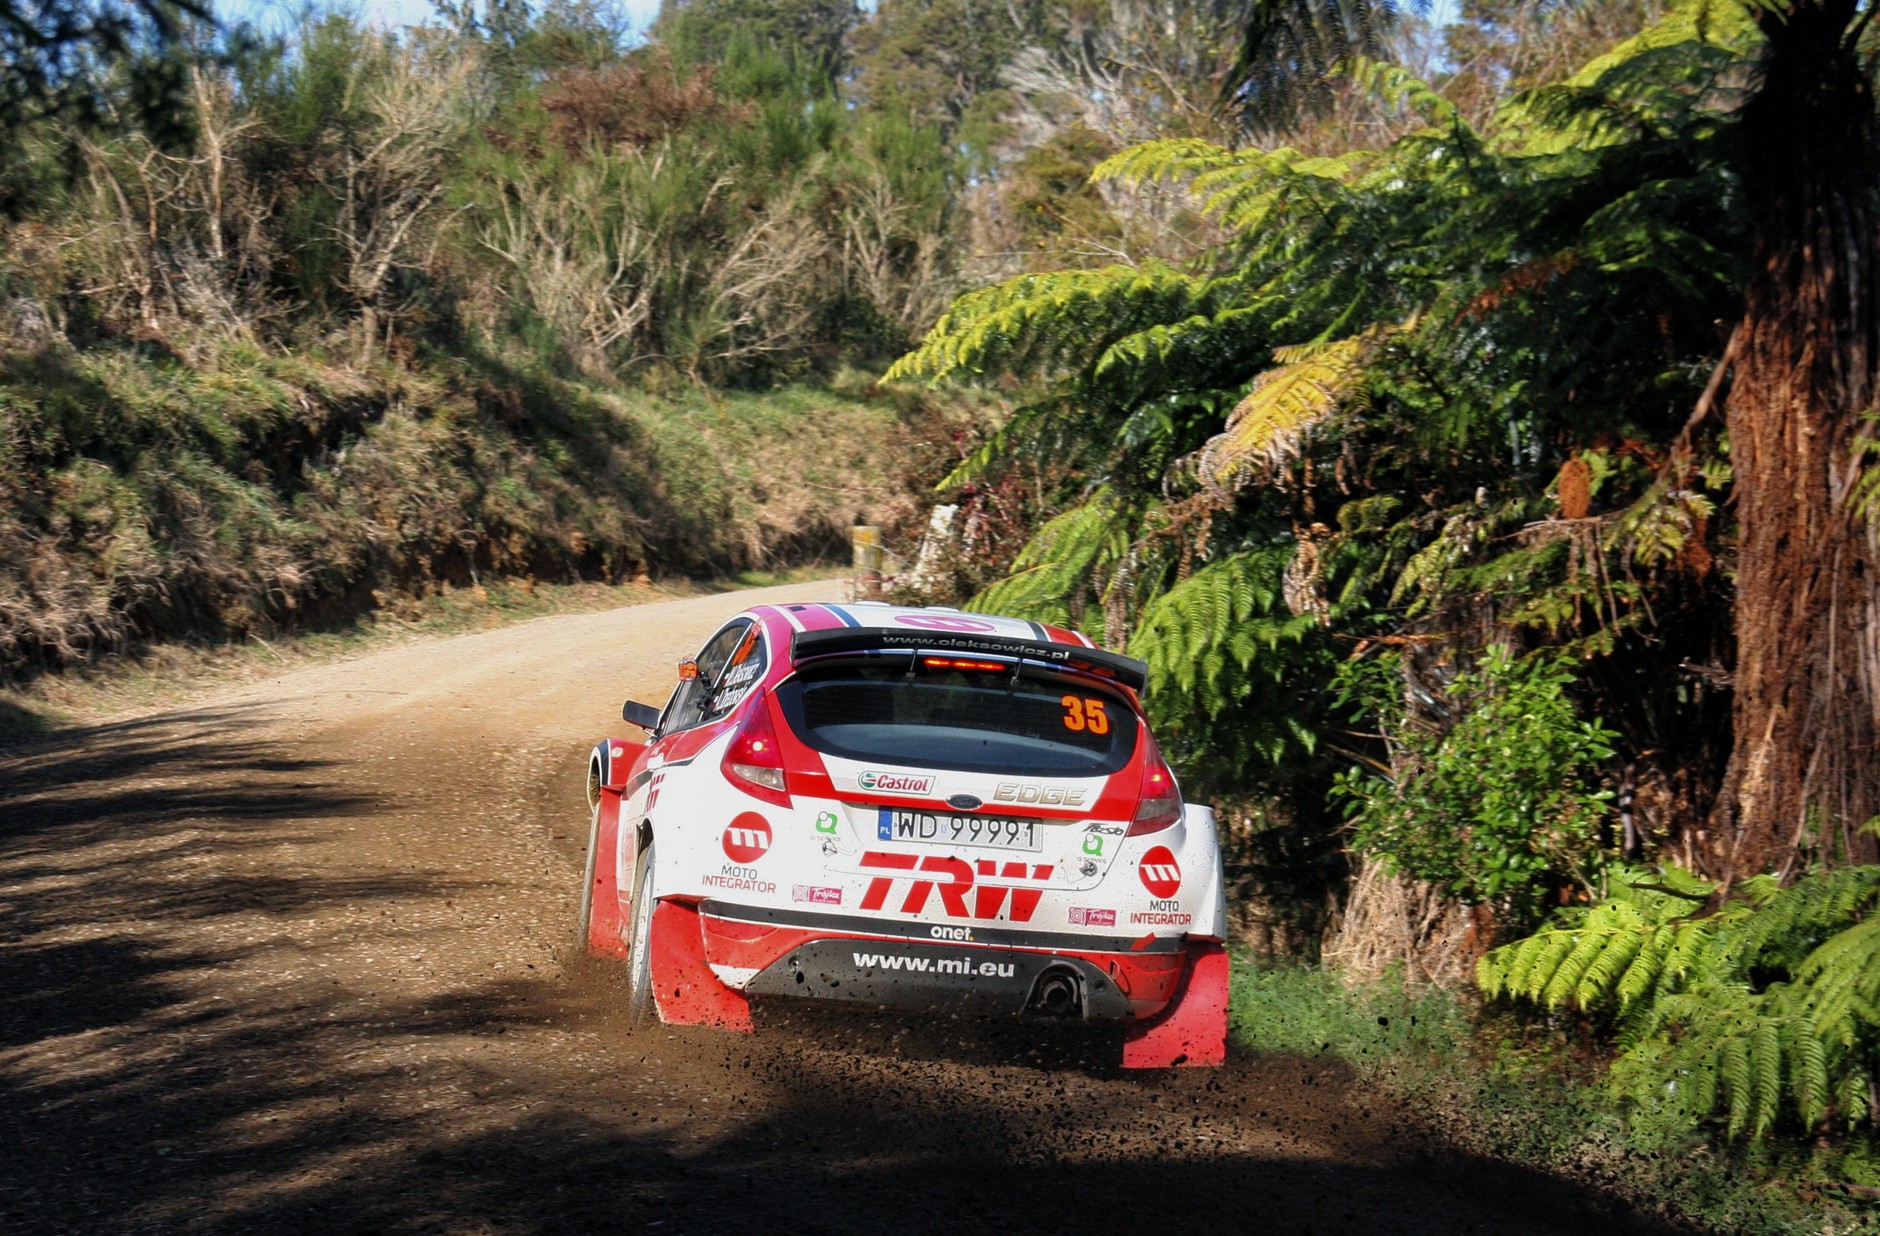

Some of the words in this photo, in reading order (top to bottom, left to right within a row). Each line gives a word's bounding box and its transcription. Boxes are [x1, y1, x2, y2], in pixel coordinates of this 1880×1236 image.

[883, 634, 1069, 660] www.oleksowicz.pl
[1060, 694, 1109, 735] 35
[876, 774, 929, 792] Castrol
[992, 782, 1088, 807] EDGE
[880, 826, 891, 835] PL
[898, 810, 938, 839] WD
[949, 816, 1035, 848] 99991
[721, 864, 758, 880] MOTO
[702, 874, 776, 894] INTEGRATOR
[859, 851, 1055, 922] TRW
[1149, 900, 1180, 912] MOTO
[1130, 912, 1192, 925] INTEGRATOR
[852, 951, 1016, 979] www.mi.eu
